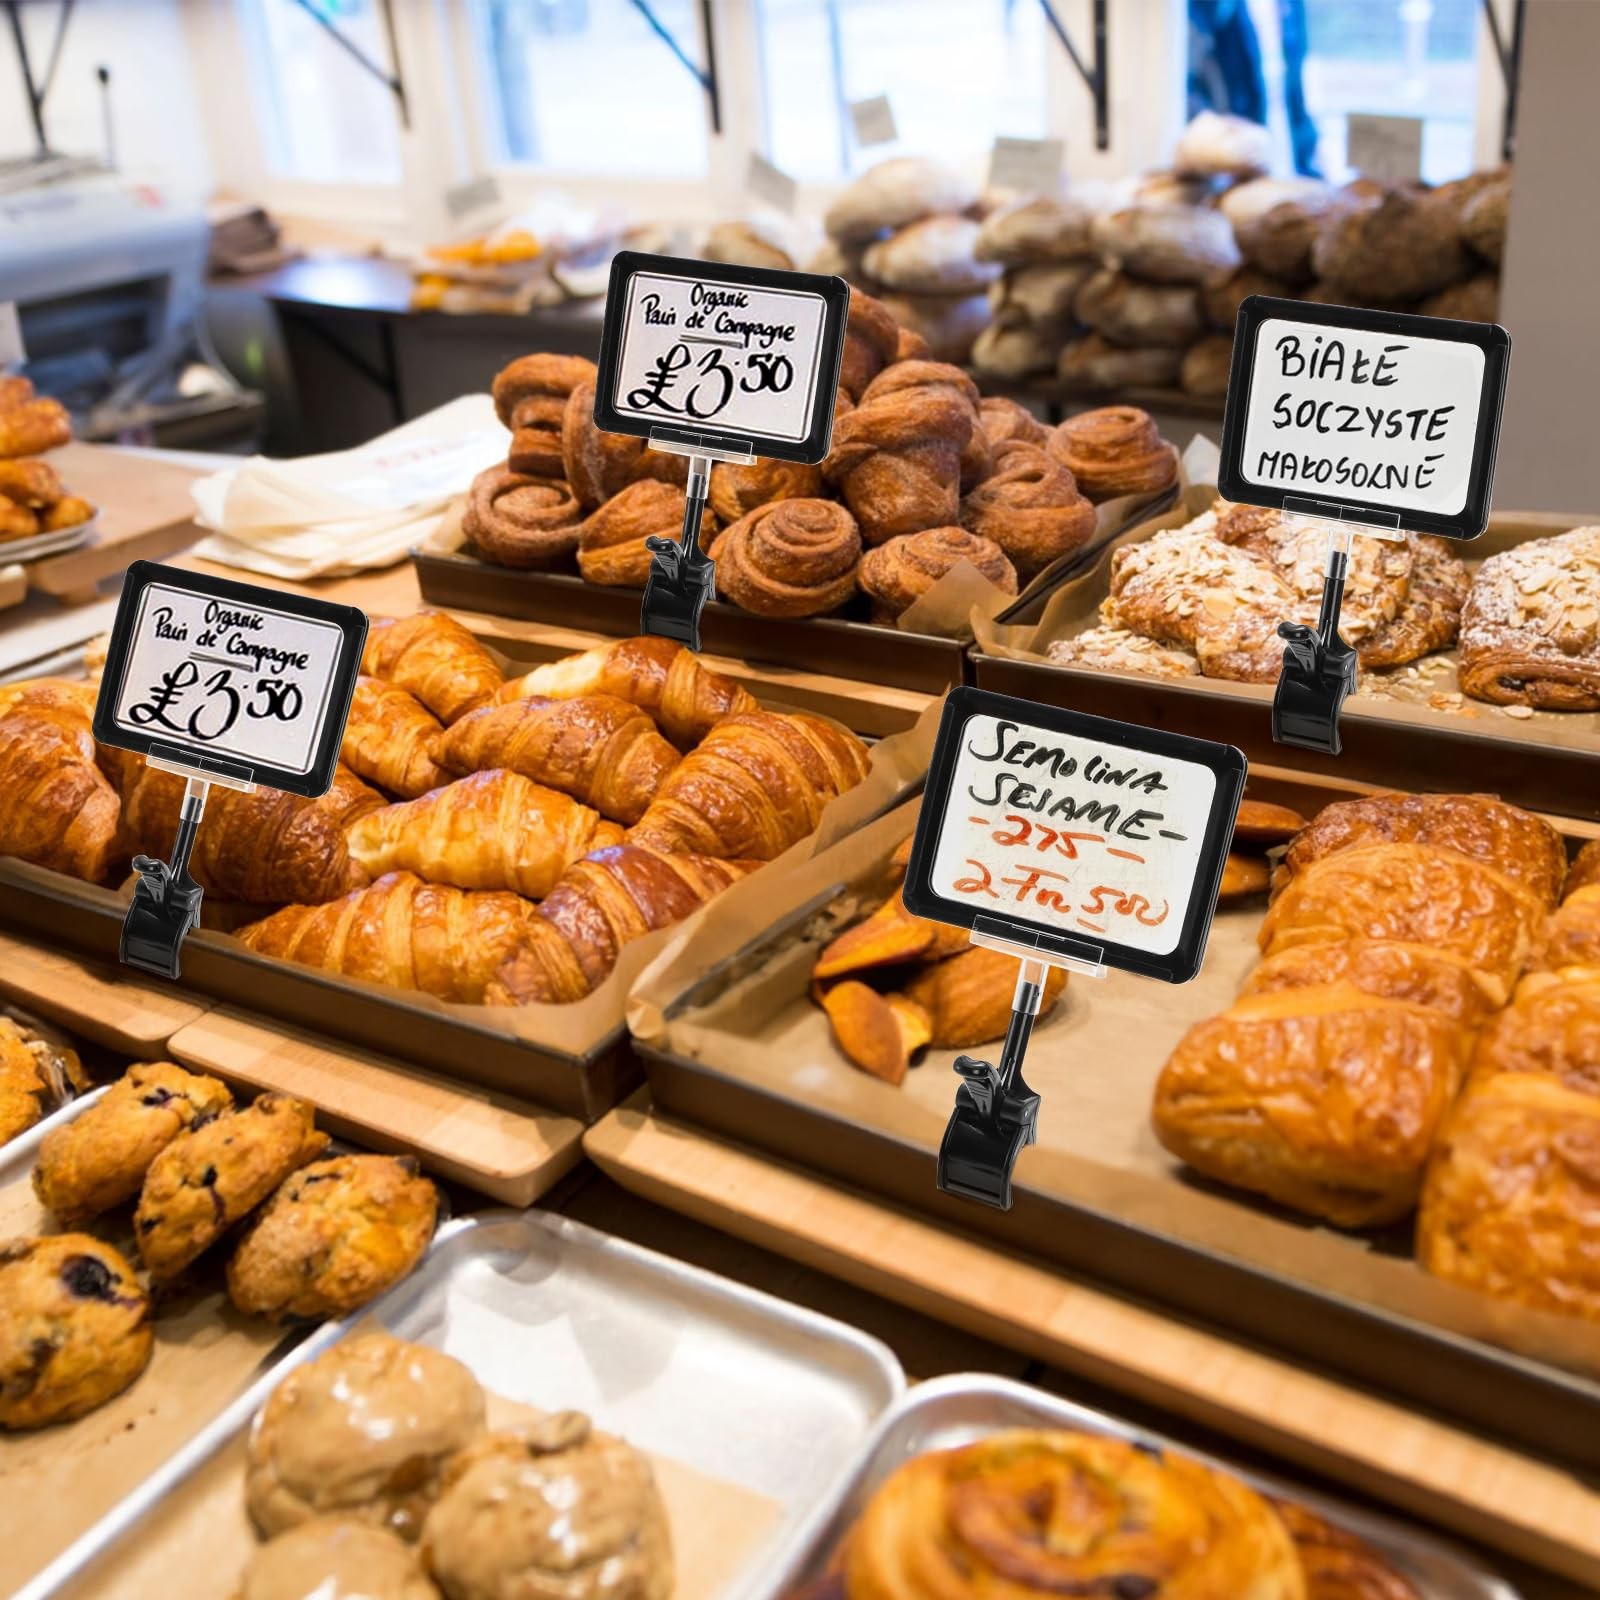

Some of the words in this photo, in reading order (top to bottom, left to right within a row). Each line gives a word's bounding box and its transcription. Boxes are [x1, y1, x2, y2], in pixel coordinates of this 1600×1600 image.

[691, 282, 749, 314] Organic
[641, 293, 677, 325] Pain
[685, 311, 705, 329] de
[715, 312, 795, 349] Campagne
[1272, 393, 1456, 441] SOCZYSTE
[204, 600, 264, 633] Organic
[152, 607, 188, 641] Pain
[196, 631, 216, 648] de
[227, 633, 309, 675] Campagne
[953, 859, 1000, 898] 2
